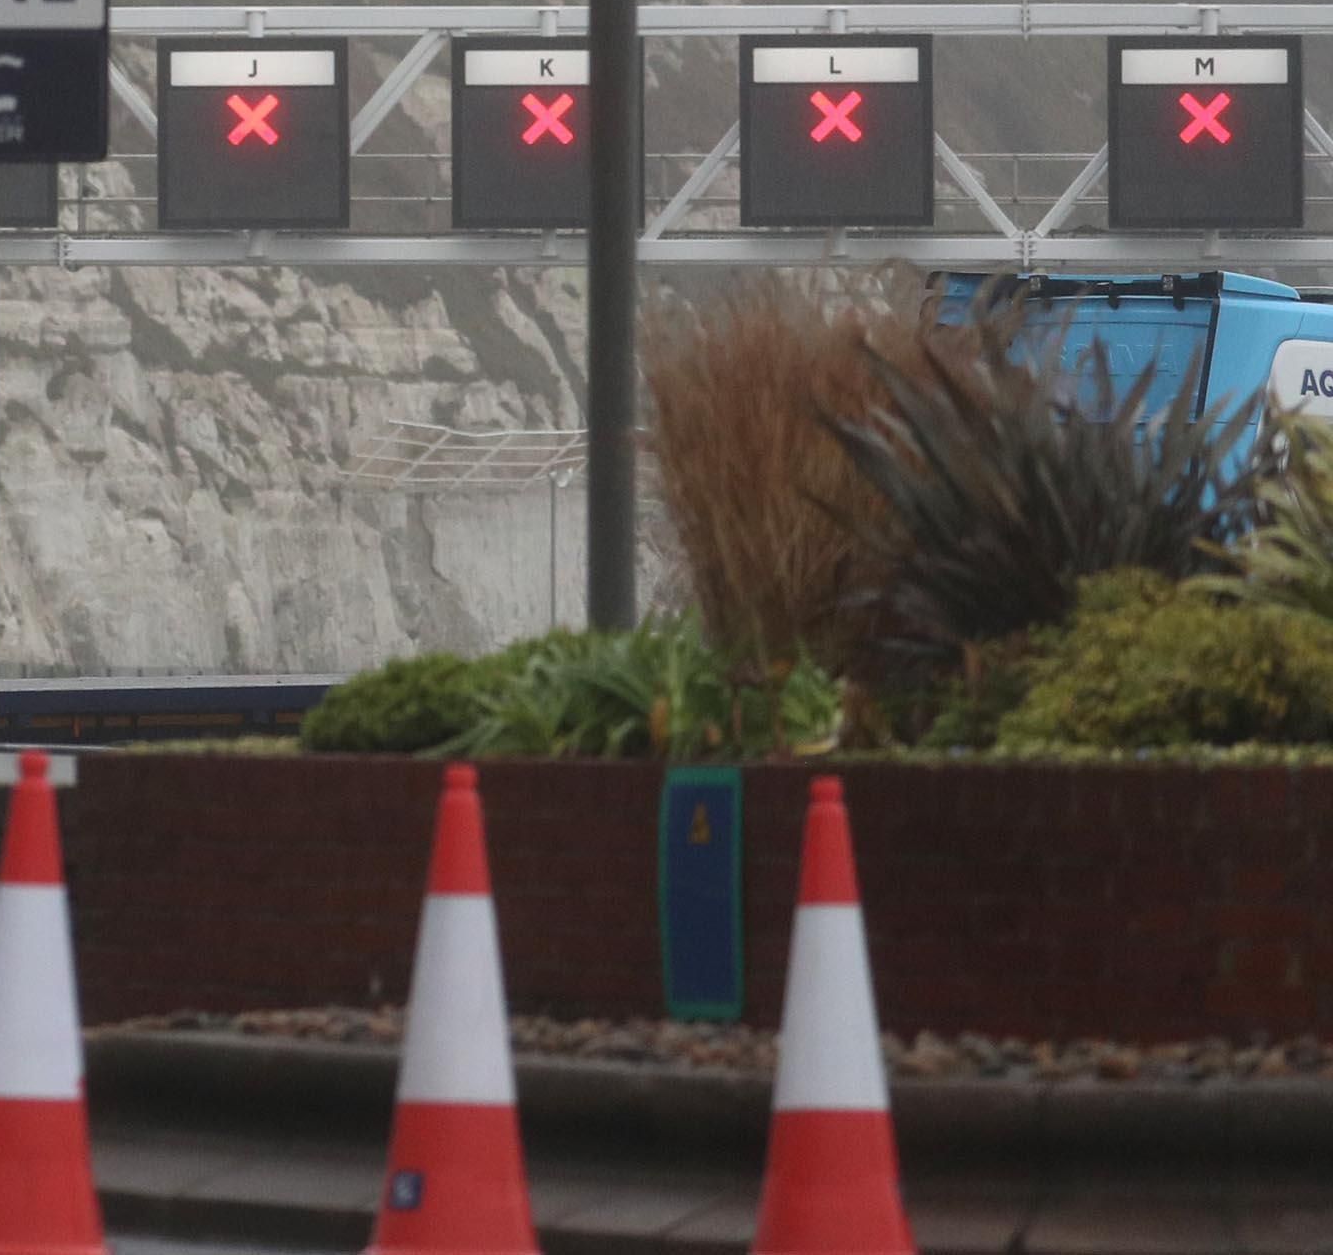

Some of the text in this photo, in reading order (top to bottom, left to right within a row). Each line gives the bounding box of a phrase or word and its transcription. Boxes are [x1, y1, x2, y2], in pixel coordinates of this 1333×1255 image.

[248, 59, 258, 78] J
[540, 58, 555, 77] K
[829, 56, 842, 75] L
[1195, 57, 1215, 76] M
